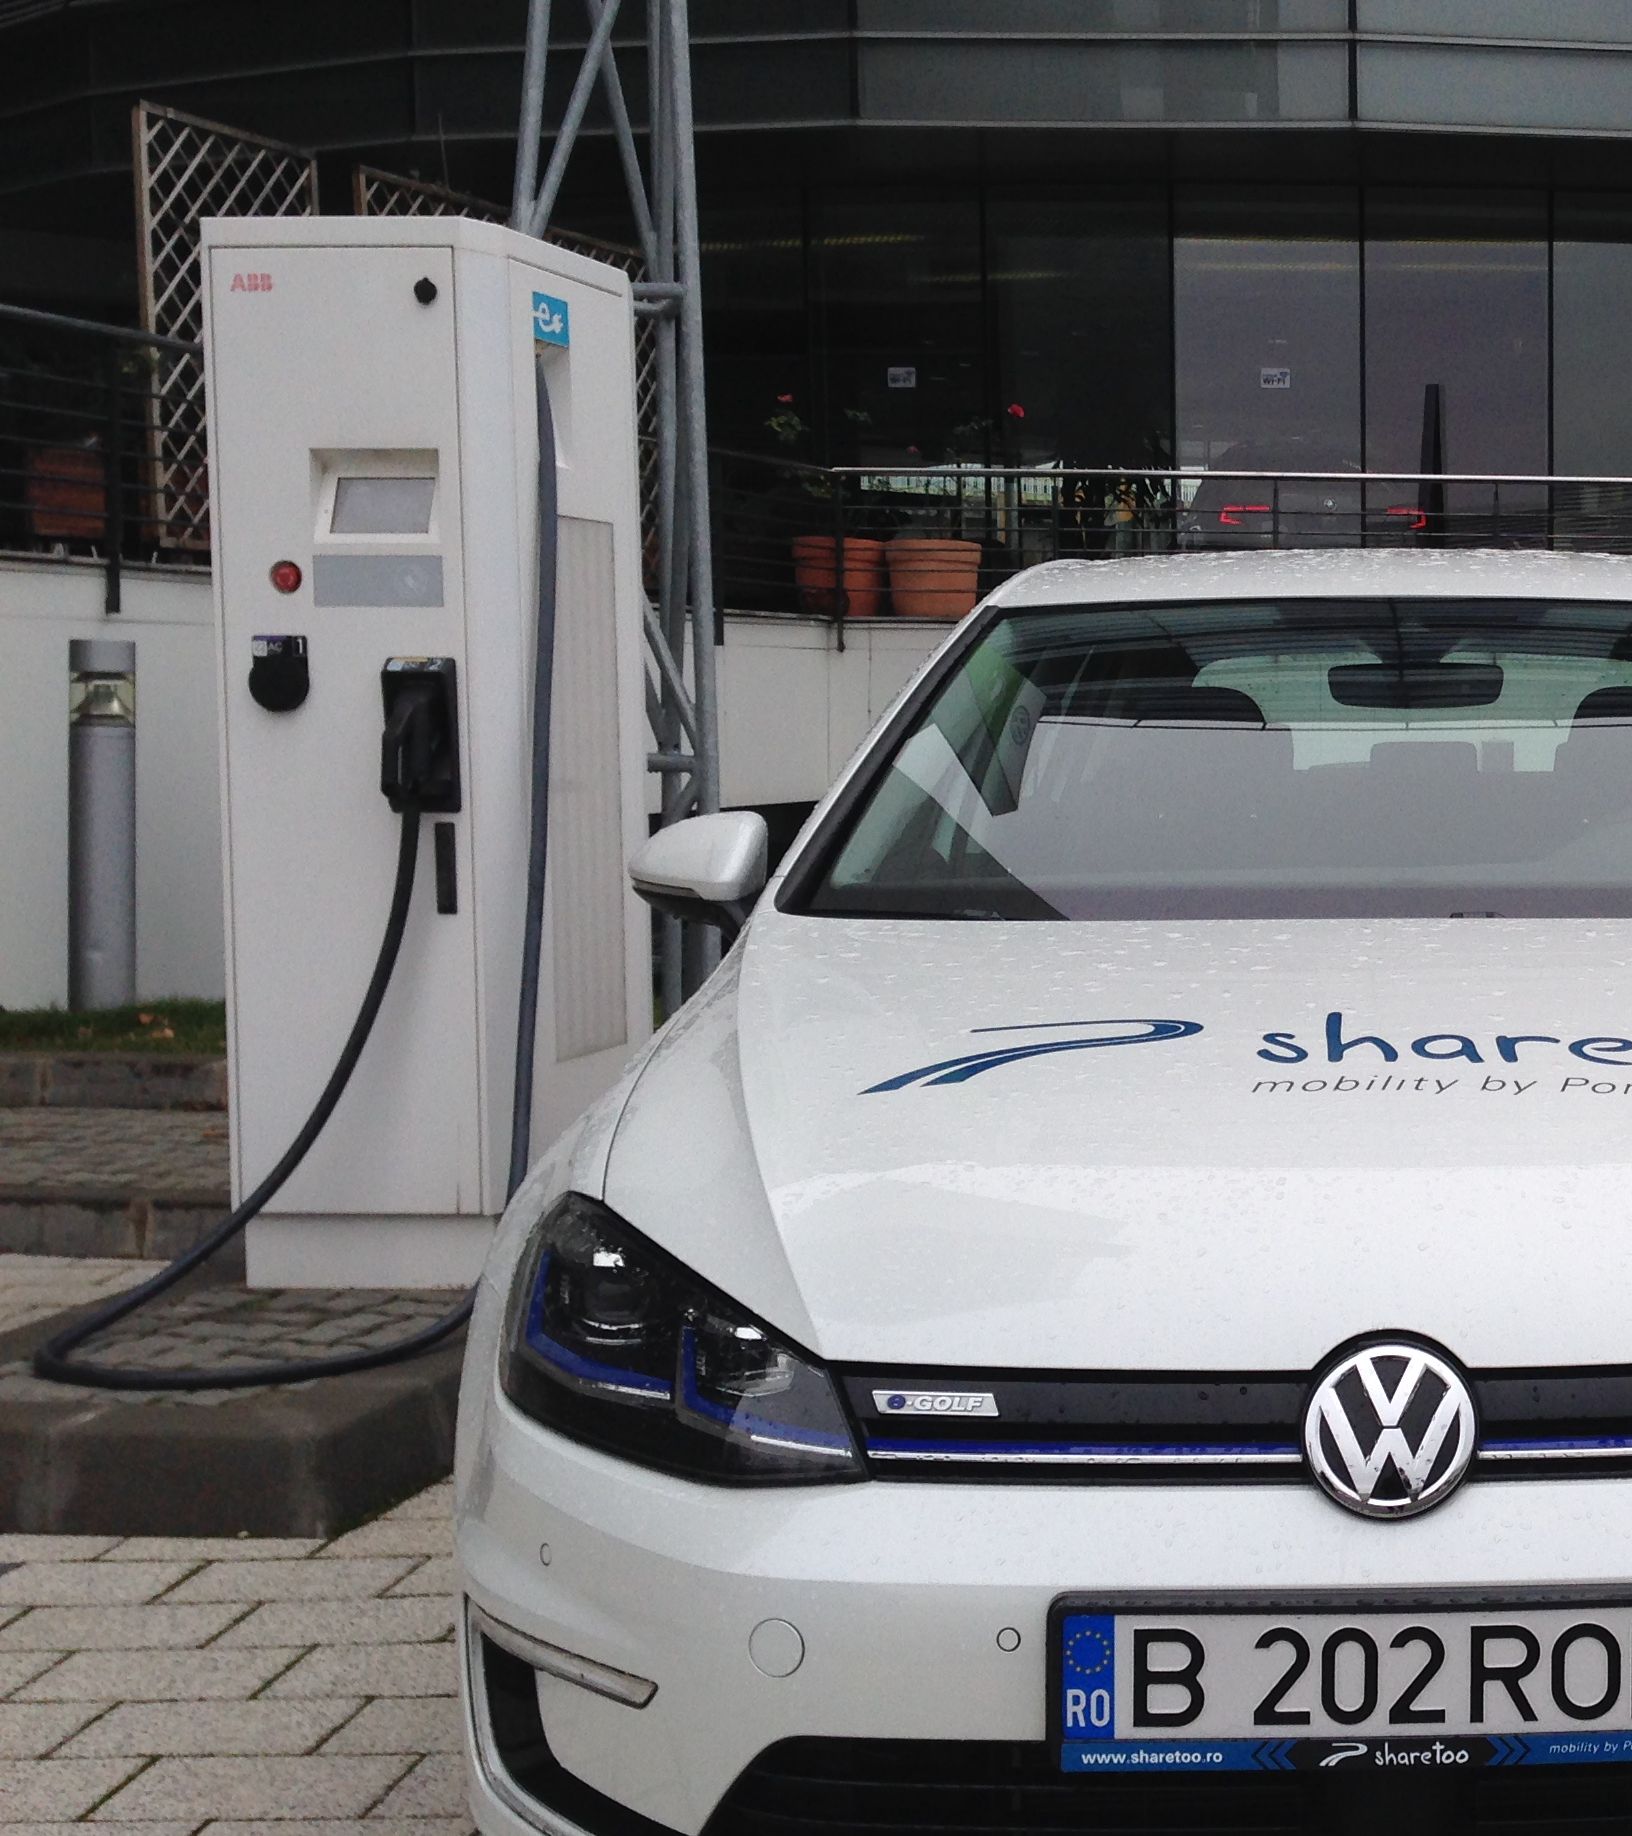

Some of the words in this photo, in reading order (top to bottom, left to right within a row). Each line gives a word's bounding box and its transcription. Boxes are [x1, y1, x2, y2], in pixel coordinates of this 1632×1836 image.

[230, 272, 273, 292] ABB
[296, 638, 303, 655] 1
[1251, 1073, 1461, 1095] mobility
[1481, 1076, 1539, 1096] by
[886, 1394, 984, 1412] e-GOLF
[1132, 1627, 1206, 1728] B
[1066, 1688, 1110, 1728] RO
[1081, 1749, 1223, 1765] www.sharetoo.ro
[1374, 1741, 1470, 1767] sharetoo
[1549, 1742, 1600, 1755] mobility
[1603, 1741, 1619, 1754] by
